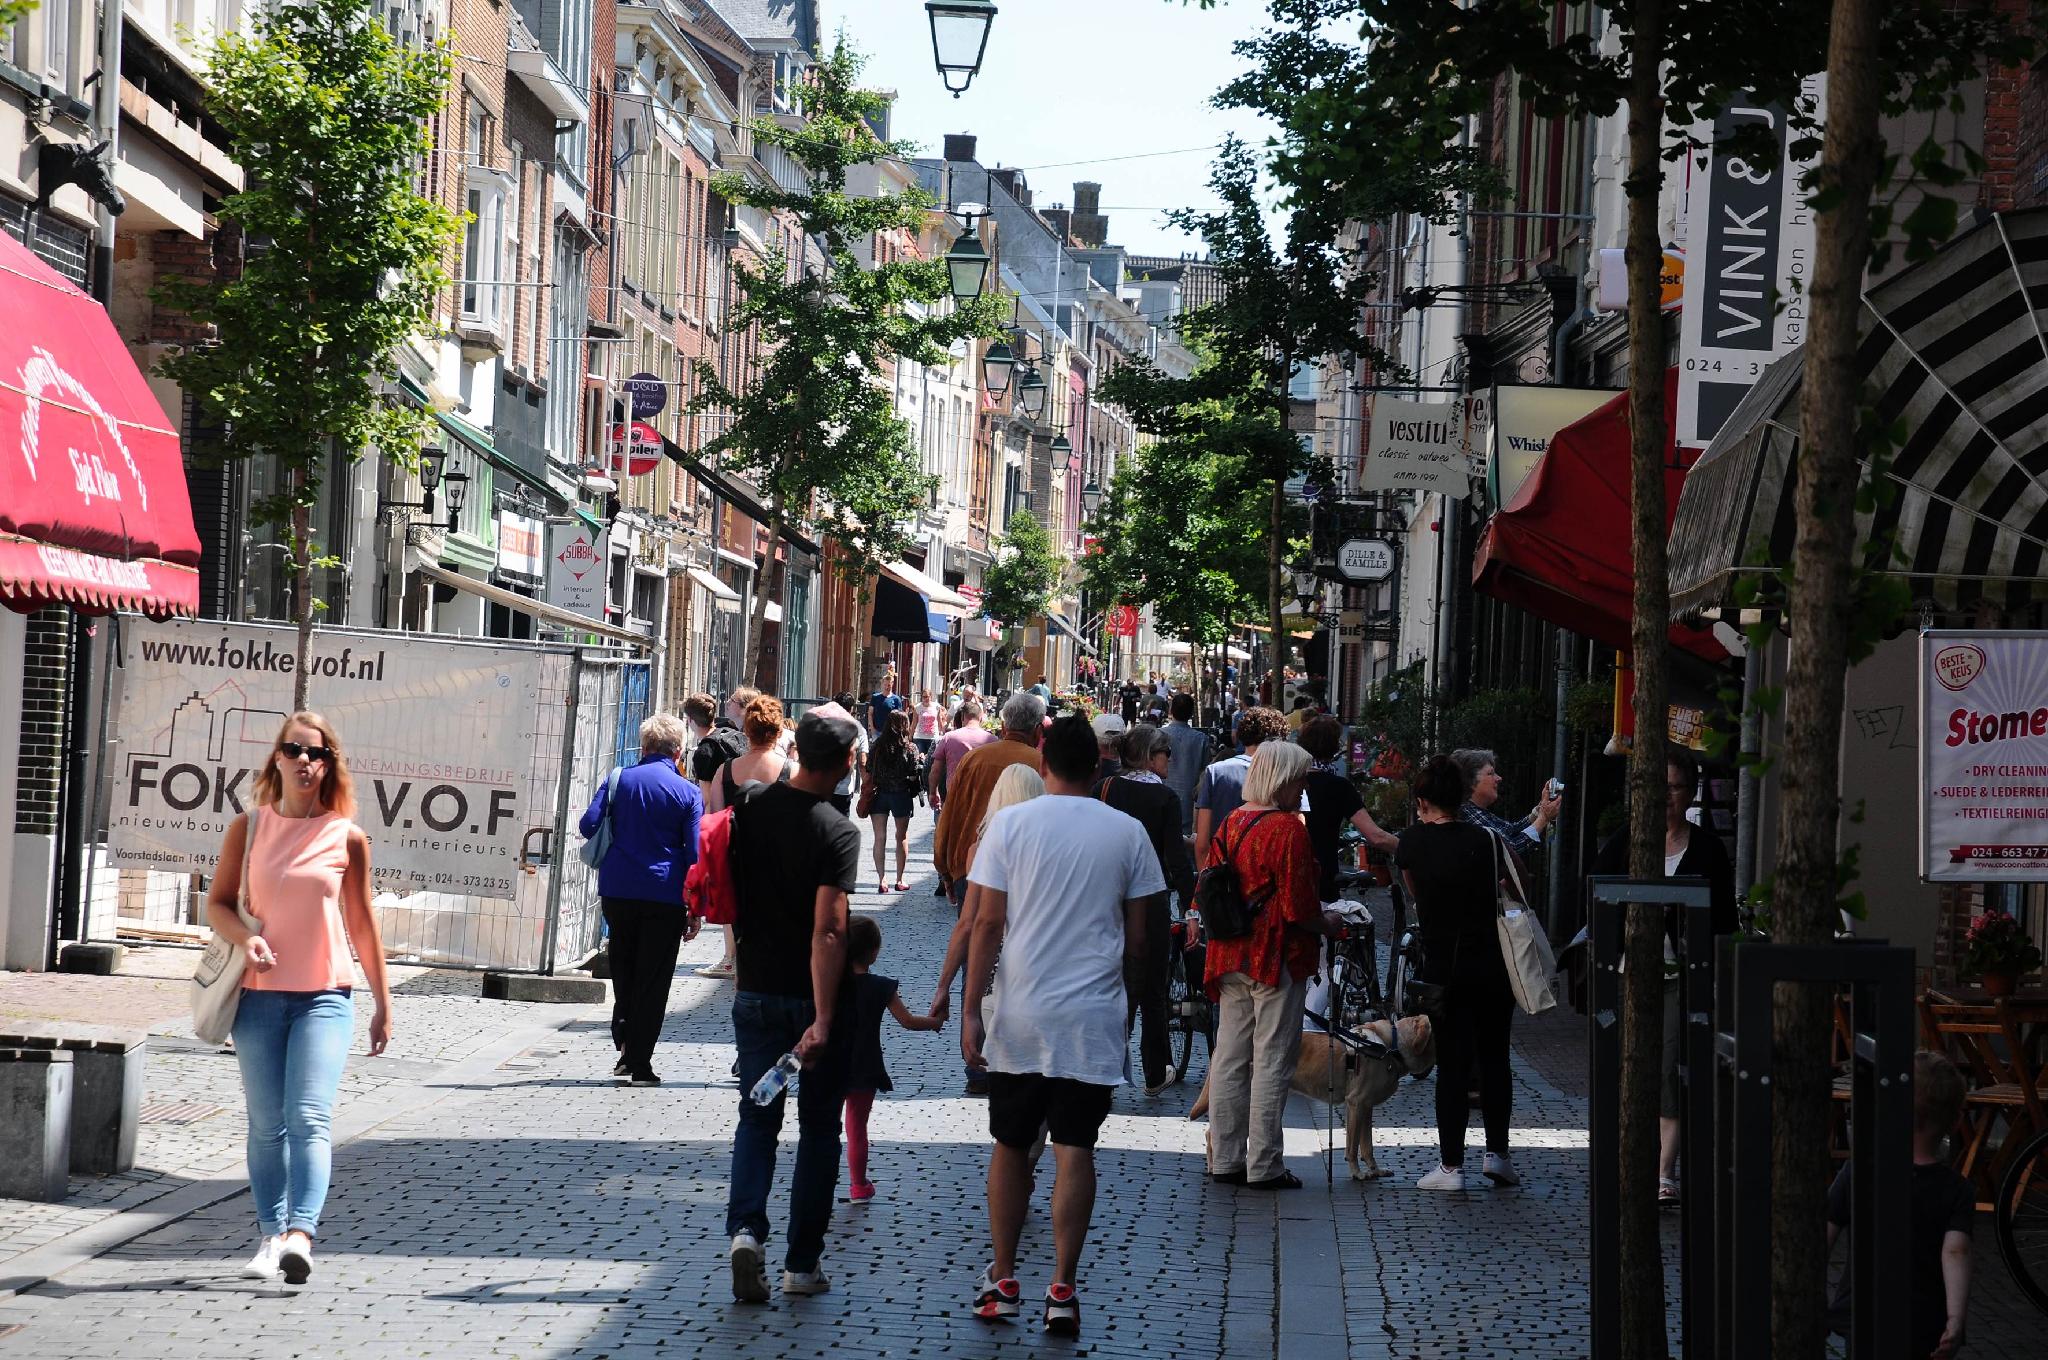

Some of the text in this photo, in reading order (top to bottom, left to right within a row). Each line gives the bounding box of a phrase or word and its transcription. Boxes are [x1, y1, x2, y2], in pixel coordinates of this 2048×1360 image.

[1717, 203, 1768, 340] VINK
[1782, 247, 1806, 345] kapsalon
[1686, 358, 1723, 373] 024
[613, 442, 658, 455] Jpiler
[1393, 472, 1417, 480] anno
[566, 545, 593, 559] SUBBA
[1348, 550, 1386, 559] DILLE &
[1345, 559, 1388, 569] KAMILLE
[1941, 653, 1965, 669] BESTE
[1950, 665, 1972, 680] KEUS
[1973, 765, 2048, 777] DRY CLEANIN
[1940, 786, 2048, 798] SUEDE & LEDERREI
[373, 779, 517, 836] V.O.F
[119, 813, 232, 833] nieuwbou
[400, 834, 506, 856] interieurs
[1972, 847, 1993, 858] 024
[2001, 847, 2022, 858] 663
[2025, 847, 2039, 858] 47
[116, 847, 185, 863] Voorstadslaan
[189, 853, 206, 865] 149
[374, 867, 387, 878] 82
[389, 868, 402, 880] 72
[409, 870, 426, 882] Fax
[435, 873, 452, 884] 024
[463, 876, 480, 887] 373
[483, 877, 495, 888] 23
[498, 879, 510, 890] 25
